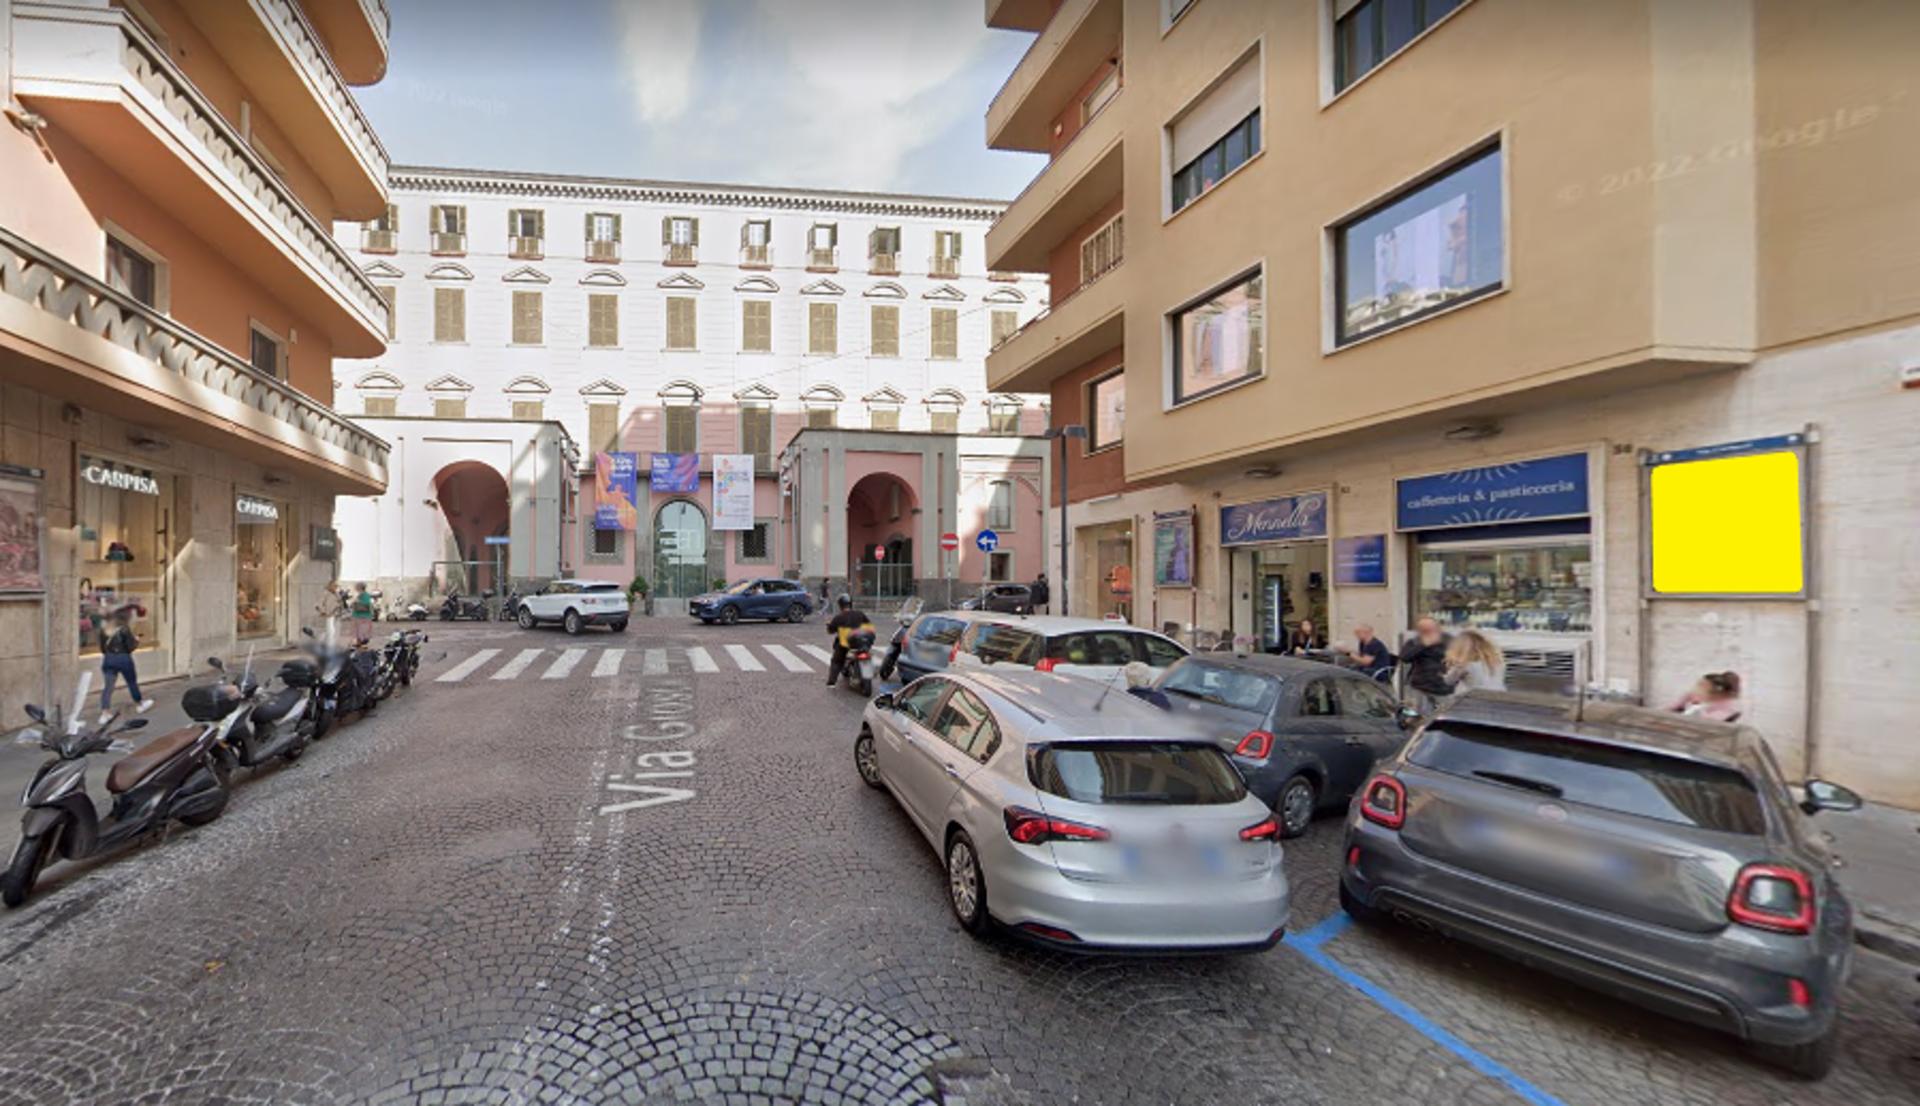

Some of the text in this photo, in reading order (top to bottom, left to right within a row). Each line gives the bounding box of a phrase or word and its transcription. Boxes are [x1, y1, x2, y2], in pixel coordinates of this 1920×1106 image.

[85, 465, 159, 496] CARPISA
[1489, 480, 1576, 502] pasticceria
[236, 497, 279, 521] CARPISA
